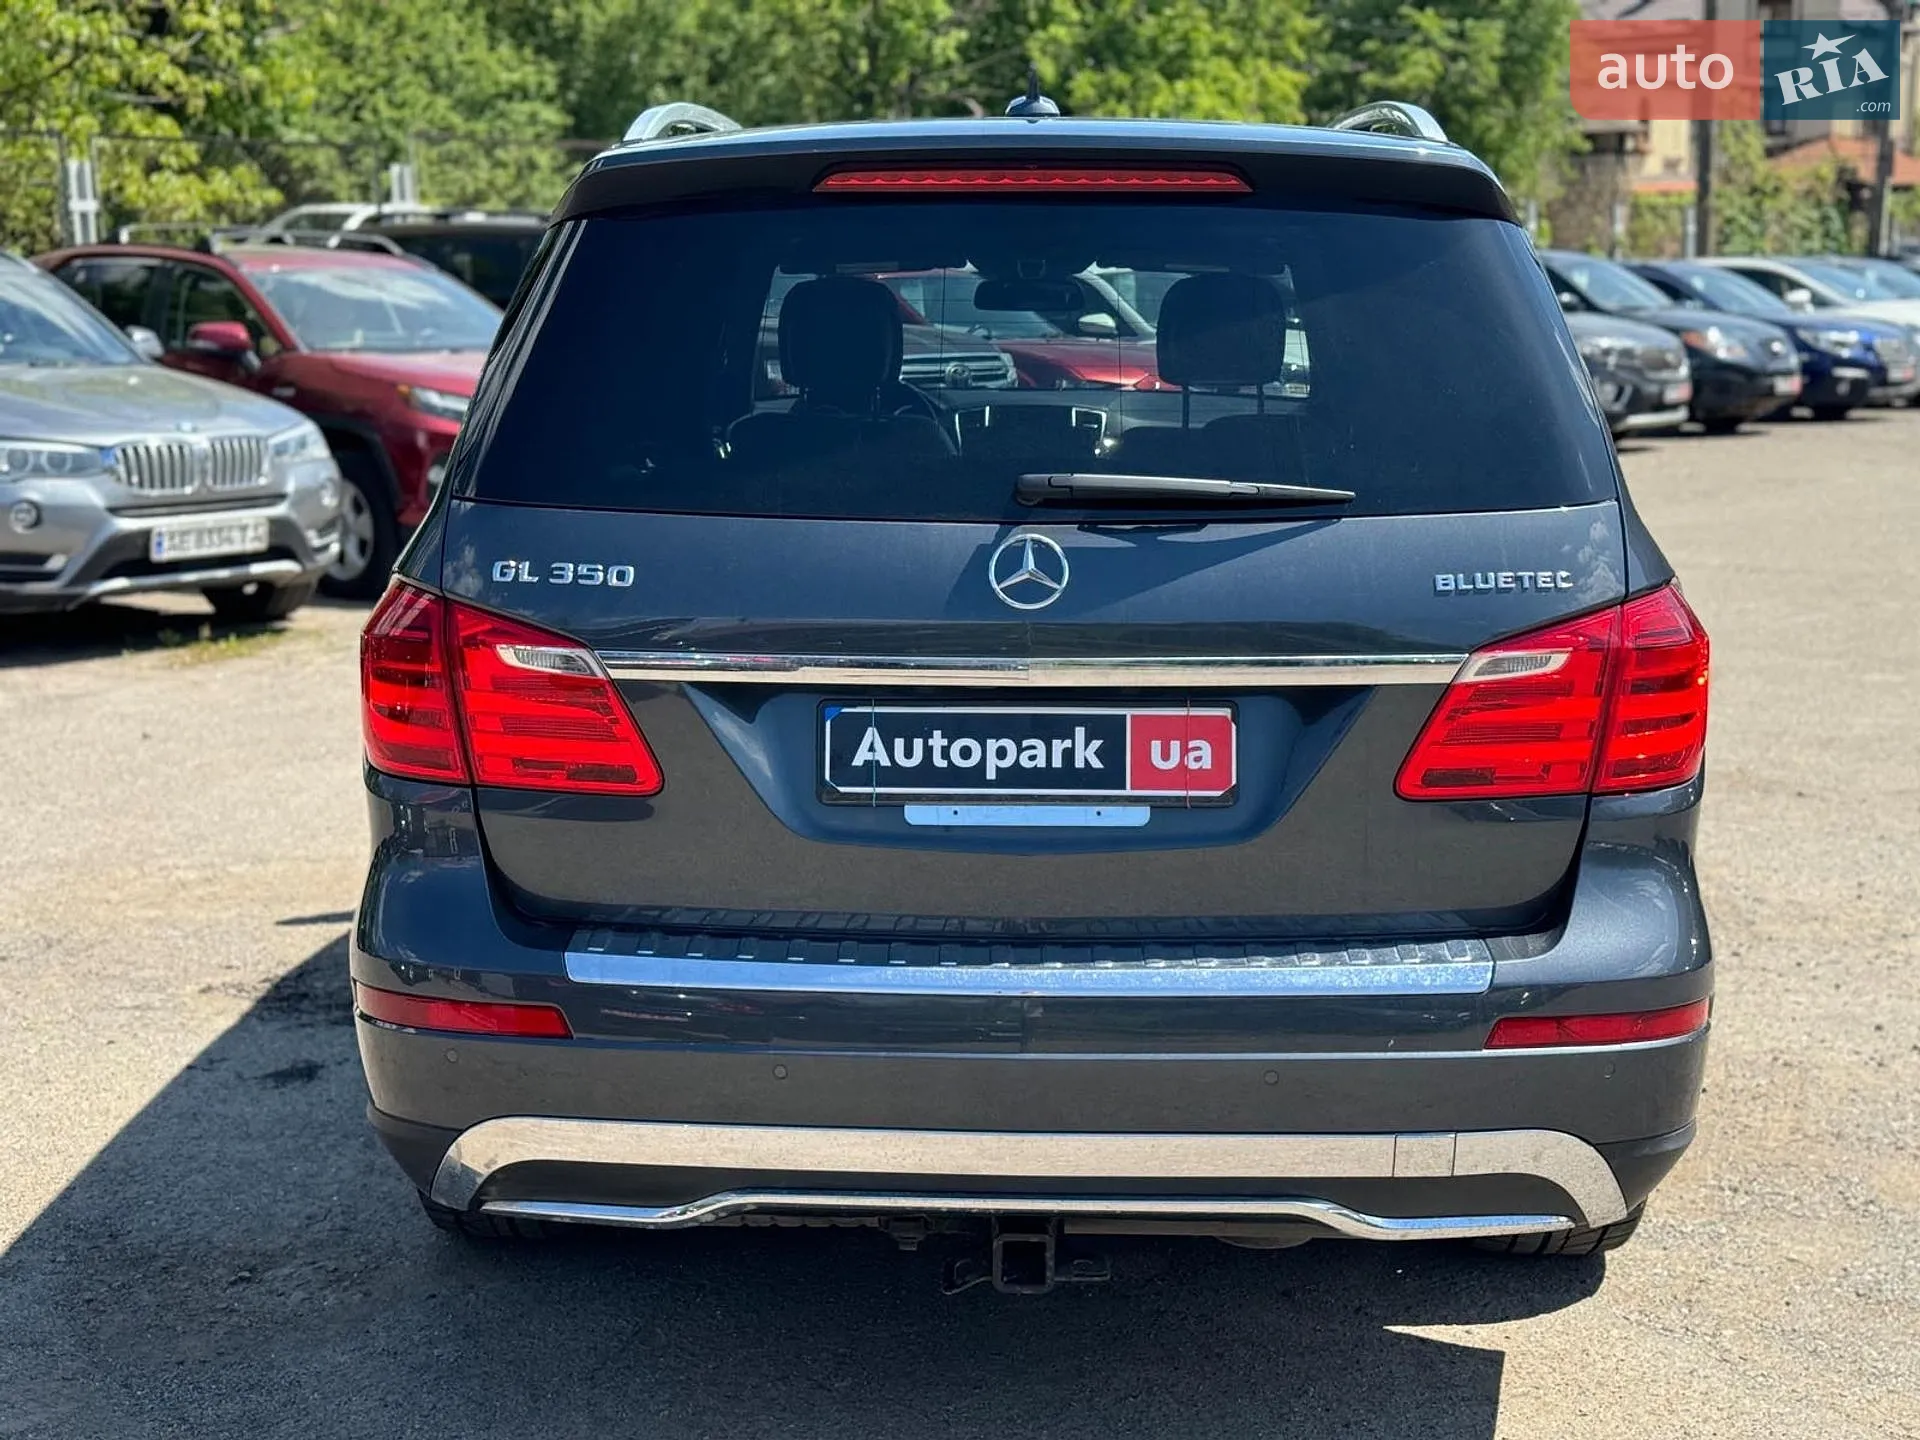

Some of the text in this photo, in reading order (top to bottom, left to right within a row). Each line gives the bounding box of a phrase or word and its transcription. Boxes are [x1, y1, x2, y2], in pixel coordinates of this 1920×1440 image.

[492, 560, 635, 588] GL 350
[1435, 570, 1574, 592] BLUETEC
[851, 726, 1213, 780] Autopark ua
